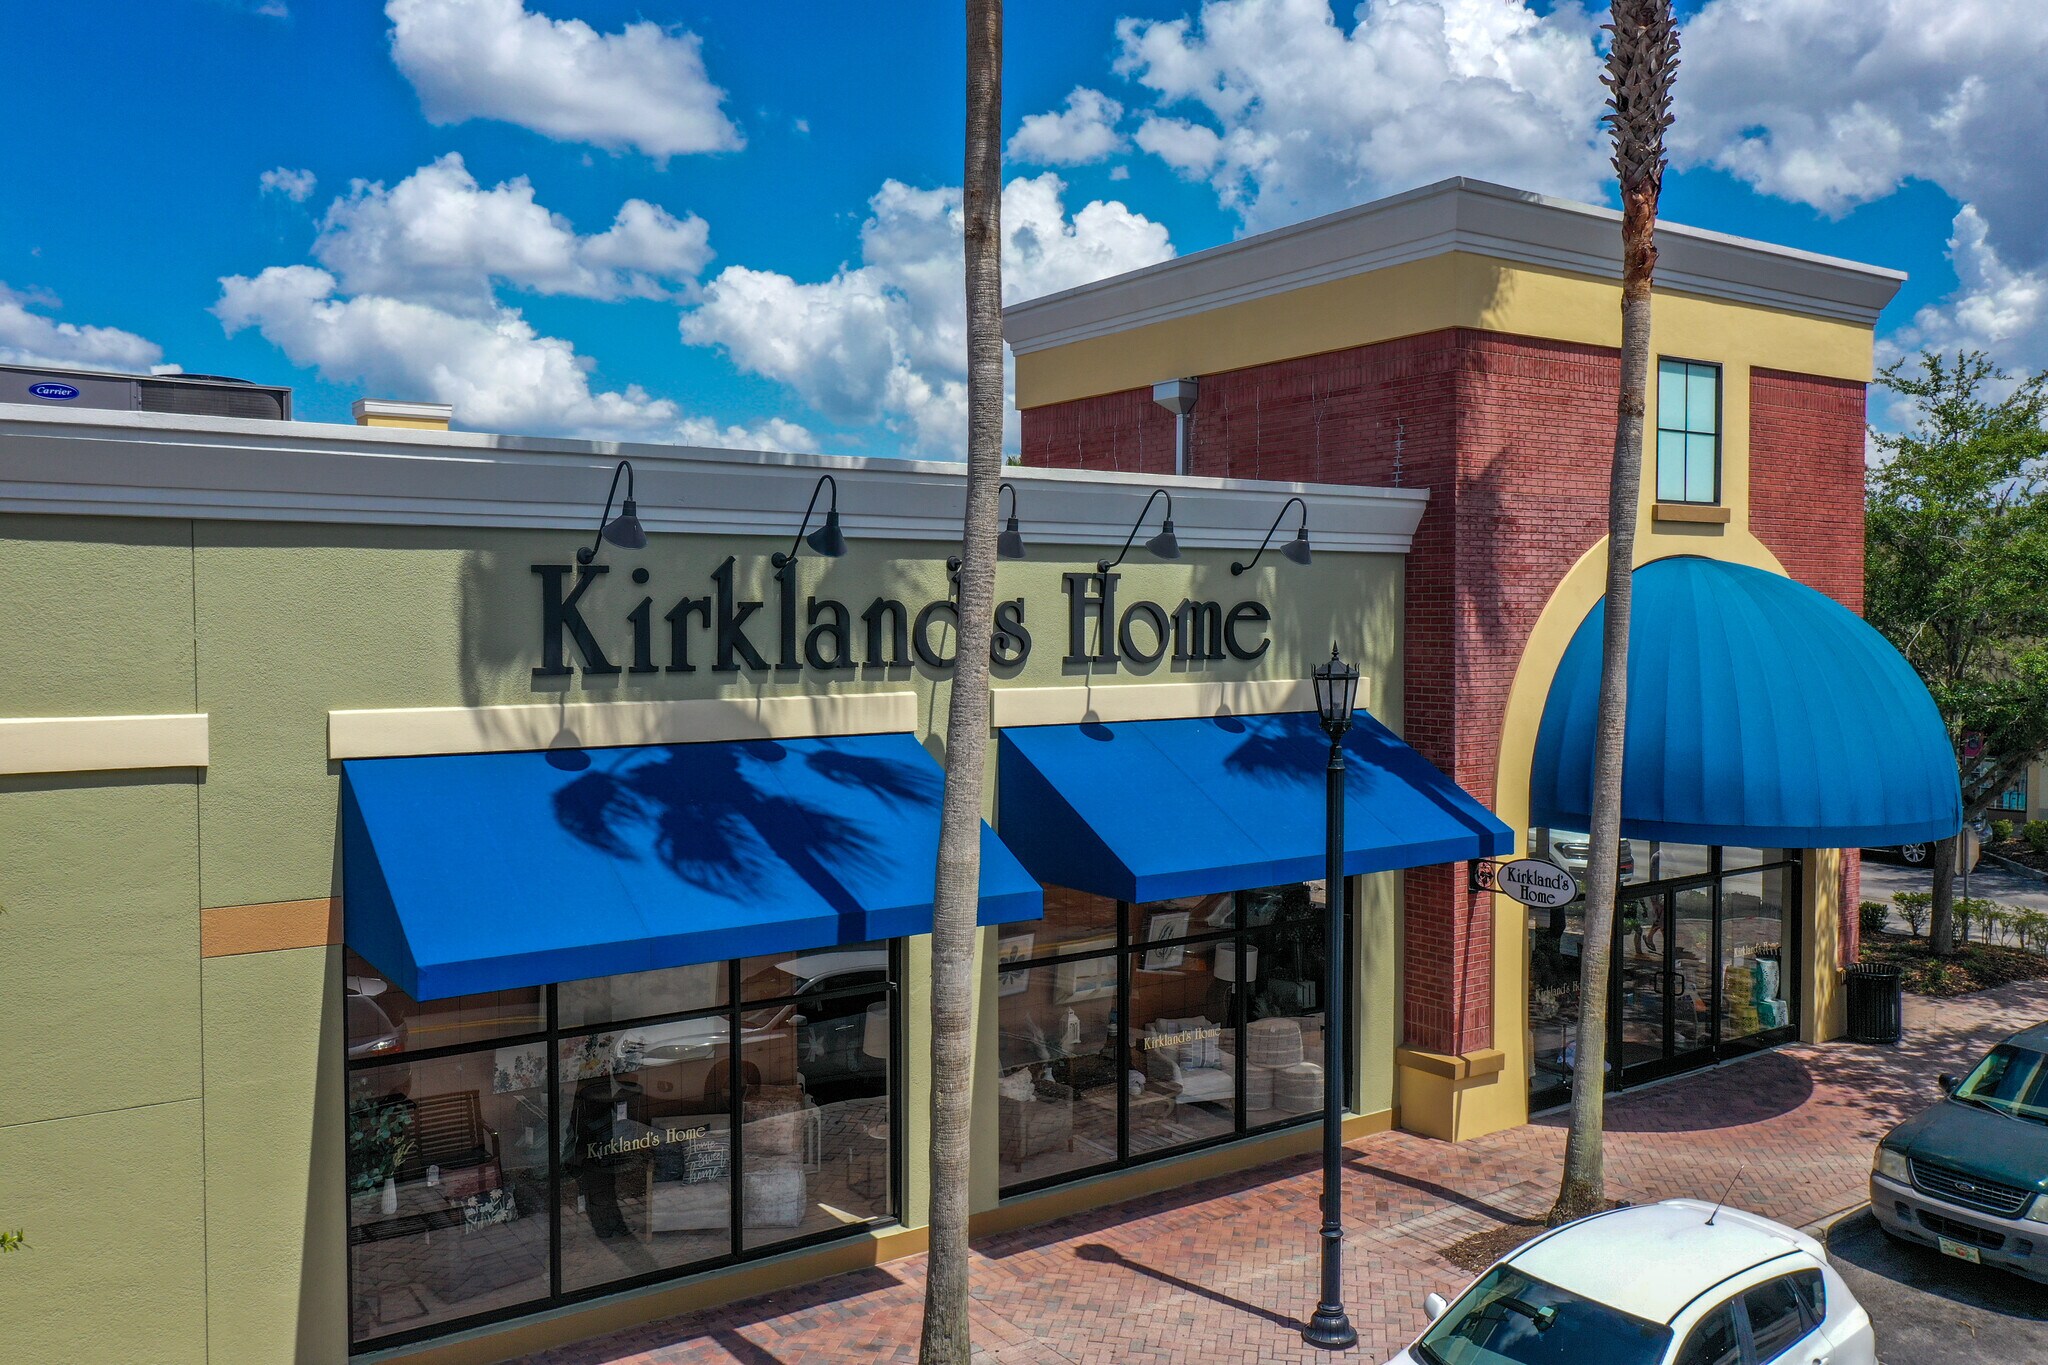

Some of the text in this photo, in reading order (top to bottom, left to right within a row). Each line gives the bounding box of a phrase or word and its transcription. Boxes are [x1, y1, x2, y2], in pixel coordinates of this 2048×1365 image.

[36, 386, 73, 396] Carrier
[531, 555, 1272, 676] Kirklands Home
[1507, 866, 1570, 891] Kirkland's
[1520, 884, 1556, 905] Home
[1143, 1028, 1221, 1050] Kirkland's Home
[586, 1125, 706, 1160] Kirkland's Home
[686, 1138, 716, 1159] Home
[688, 1161, 719, 1184] home
